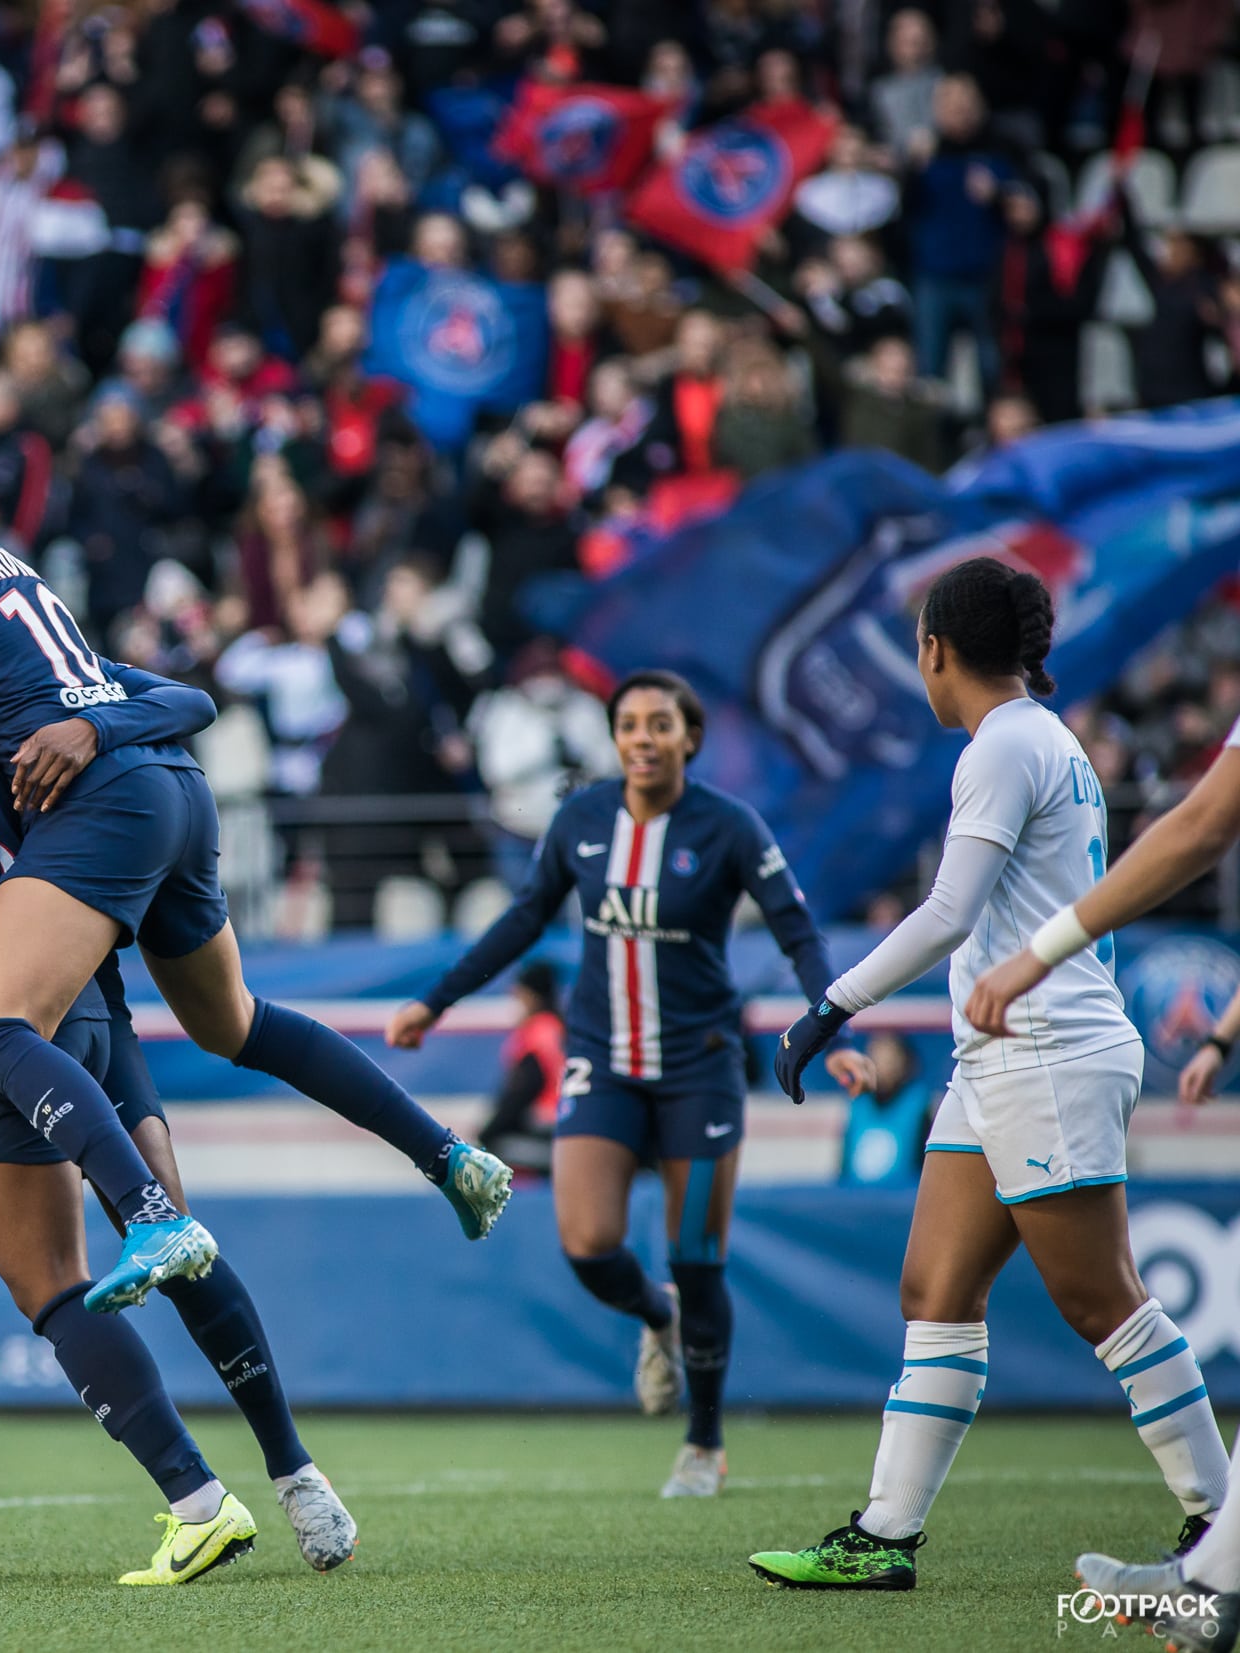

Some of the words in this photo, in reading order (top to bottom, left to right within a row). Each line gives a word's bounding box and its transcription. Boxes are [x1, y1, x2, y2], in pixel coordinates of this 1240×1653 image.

[41, 1104, 52, 1115] 10
[43, 1102, 74, 1143] ARIS
[227, 1363, 268, 1390] PARIS
